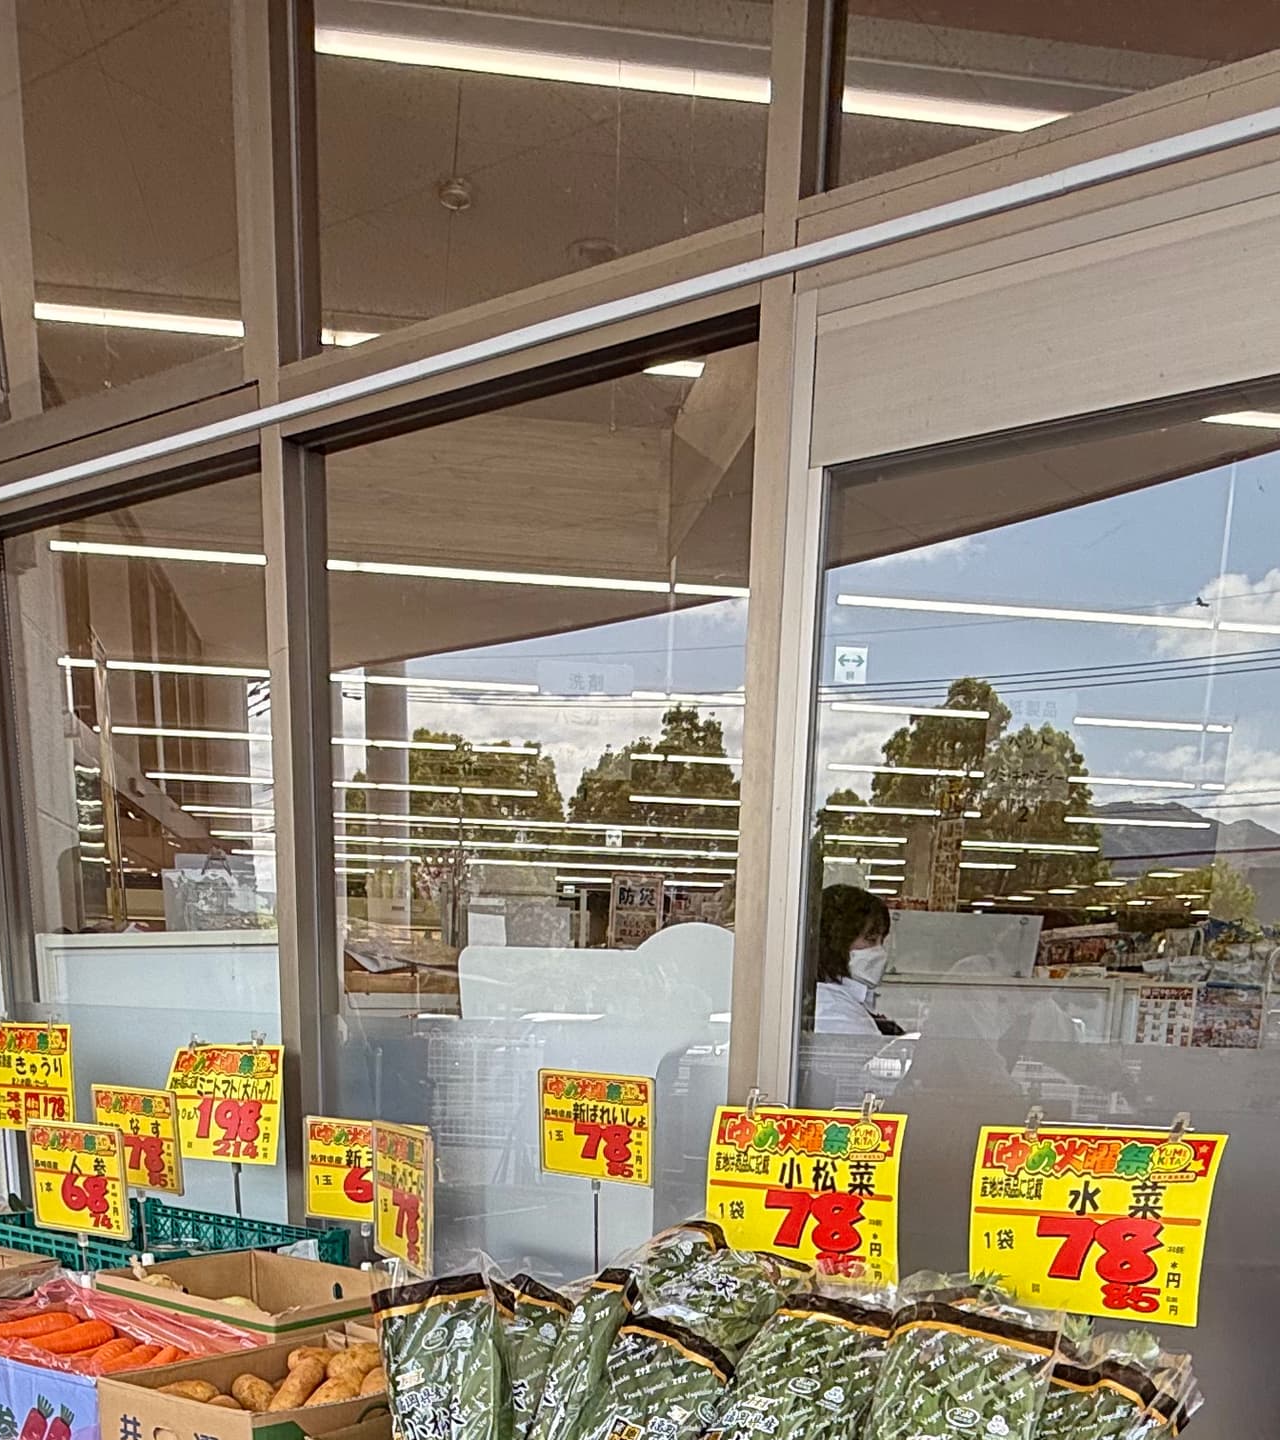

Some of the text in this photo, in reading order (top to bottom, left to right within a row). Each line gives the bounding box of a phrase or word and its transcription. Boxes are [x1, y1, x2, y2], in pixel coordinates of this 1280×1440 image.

[15, 1056, 64, 1078] きゅうり
[43, 1095, 65, 1119] 178
[195, 1097, 263, 1142] 198
[129, 1117, 161, 1139] なす
[123, 1134, 165, 1173] 78
[212, 1139, 259, 1159] 214
[574, 1121, 633, 1163] 78
[70, 1155, 107, 1177] 人参
[779, 1157, 876, 1196] 小松菜
[61, 1172, 110, 1214] 68
[315, 1174, 333, 1186] 1玉
[718, 1200, 745, 1220] 1袋
[1067, 1180, 1166, 1219] 水菜
[89, 1212, 114, 1230] 74
[391, 1187, 421, 1245] 78
[763, 1188, 867, 1254] 78
[983, 1228, 1014, 1250] 1袋
[1036, 1215, 1165, 1286] 78
[1166, 1271, 1181, 1288] 円
[1100, 1282, 1162, 1313] 85
